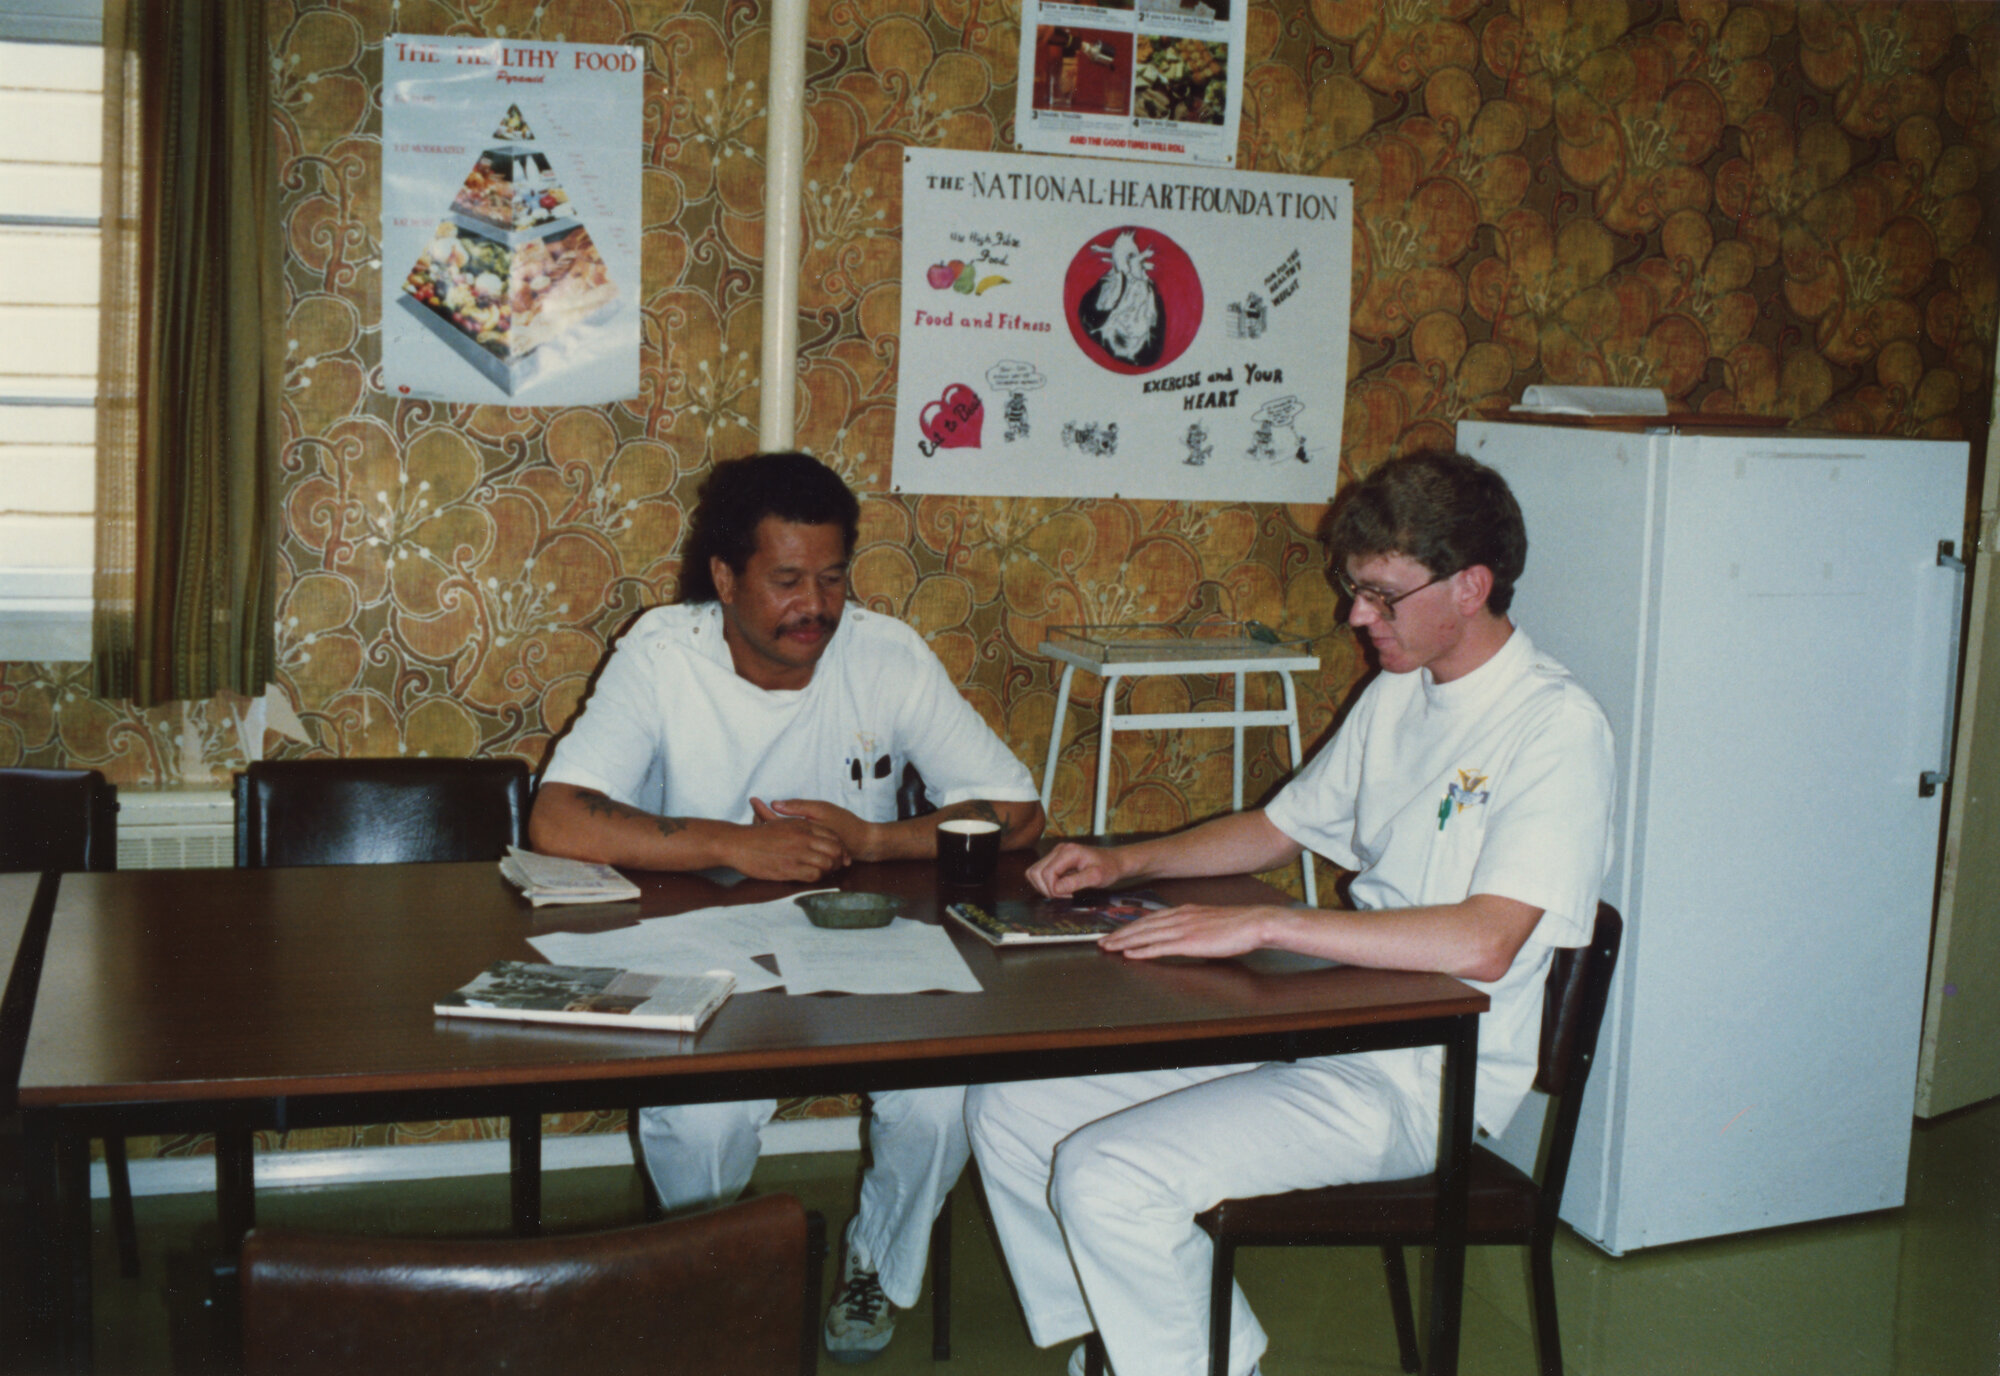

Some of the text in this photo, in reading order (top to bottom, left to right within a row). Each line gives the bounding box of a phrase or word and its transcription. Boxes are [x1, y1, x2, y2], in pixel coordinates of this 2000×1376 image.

[394, 43, 440, 63] THE
[574, 52, 637, 73] FOOD
[1069, 135, 1185, 153] AND THE GOOD TIMES WILL ROLL
[926, 171, 1338, 220] THE NATIONAL HEART FOUNDATION
[915, 309, 1052, 332] Food and Fitness
[1143, 371, 1201, 394] EXERCISE
[1207, 367, 1234, 383] and
[1183, 389, 1239, 411] HEART
[918, 432, 944, 458] Eat
[944, 419, 958, 432] to
